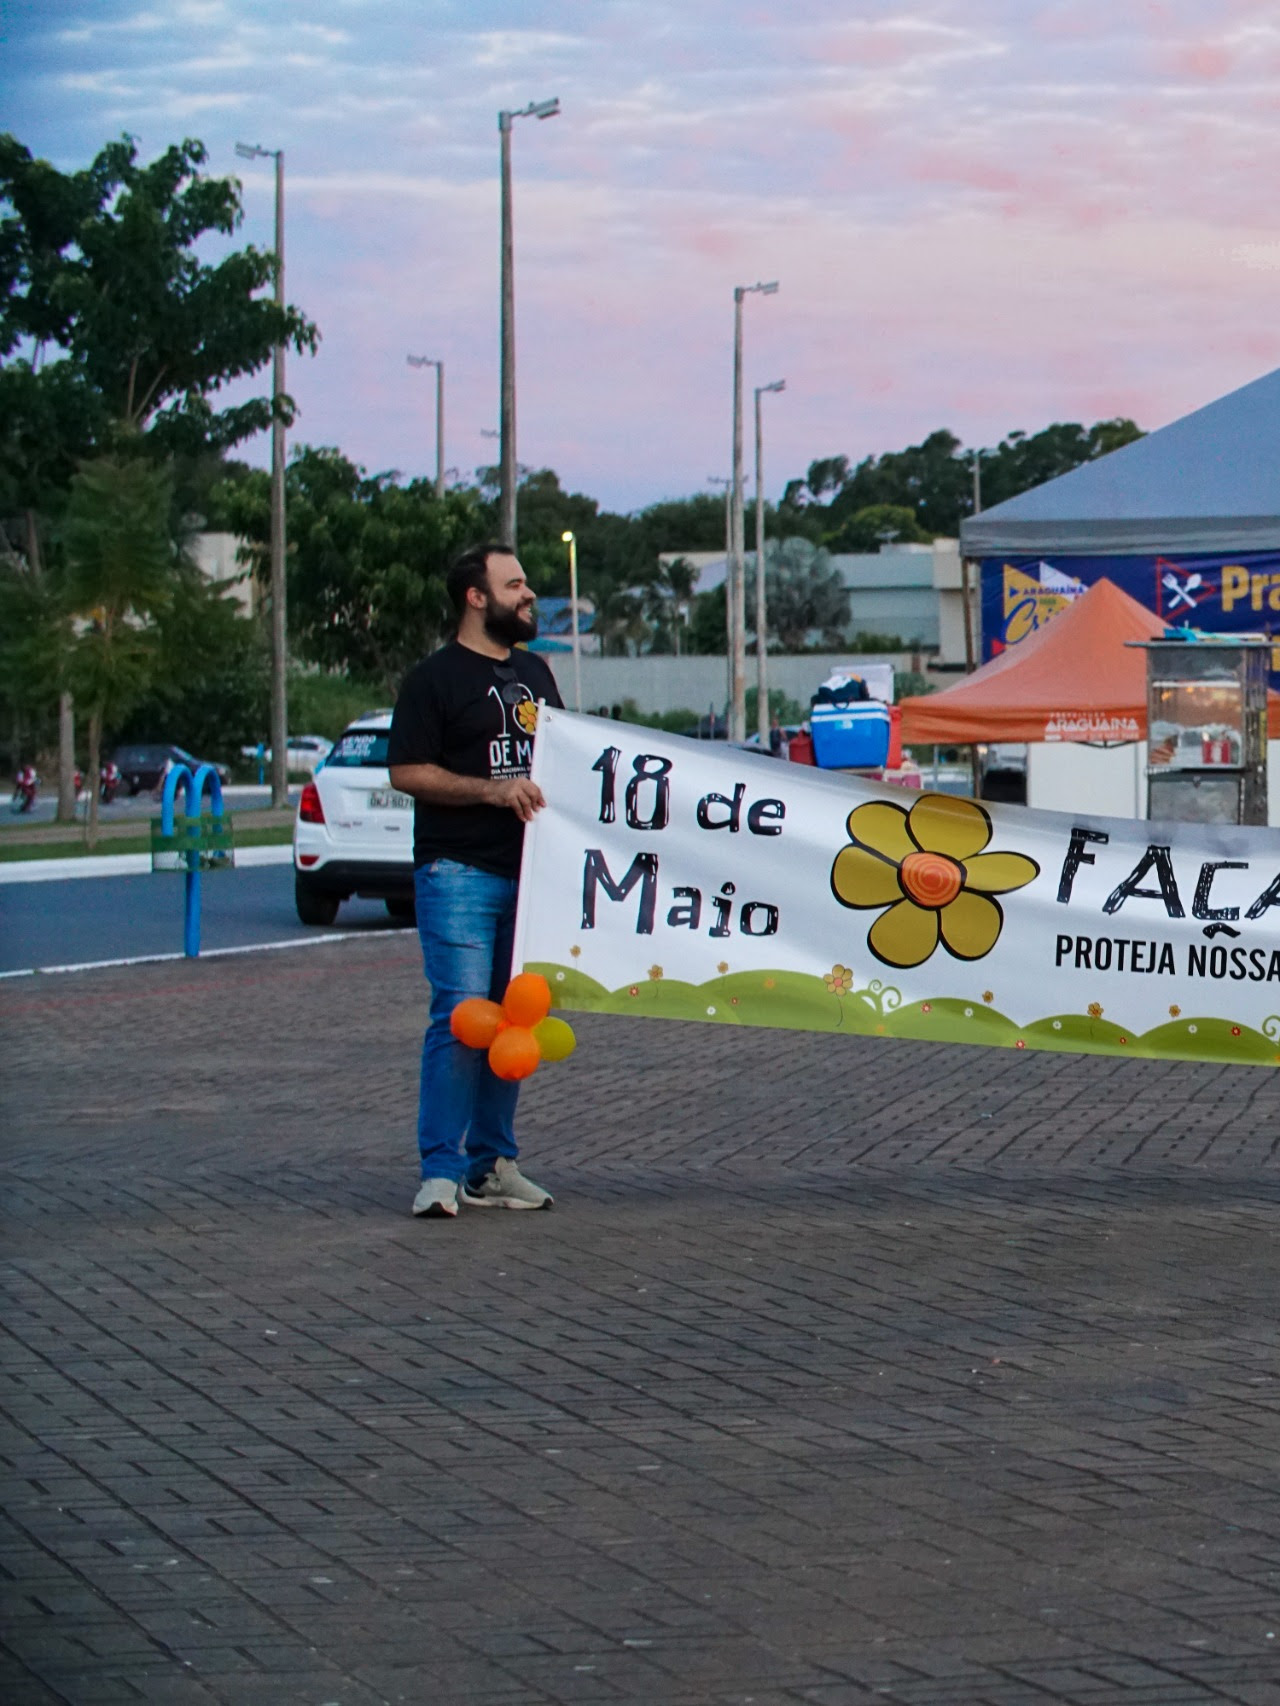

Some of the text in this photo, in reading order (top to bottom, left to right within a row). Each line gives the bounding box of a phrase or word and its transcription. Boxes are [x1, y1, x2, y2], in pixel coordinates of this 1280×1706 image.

[489, 740, 512, 767] DE
[591, 746, 786, 836] 18 de
[581, 849, 779, 938] Maio
[1055, 934, 1176, 976] PROTEJA
